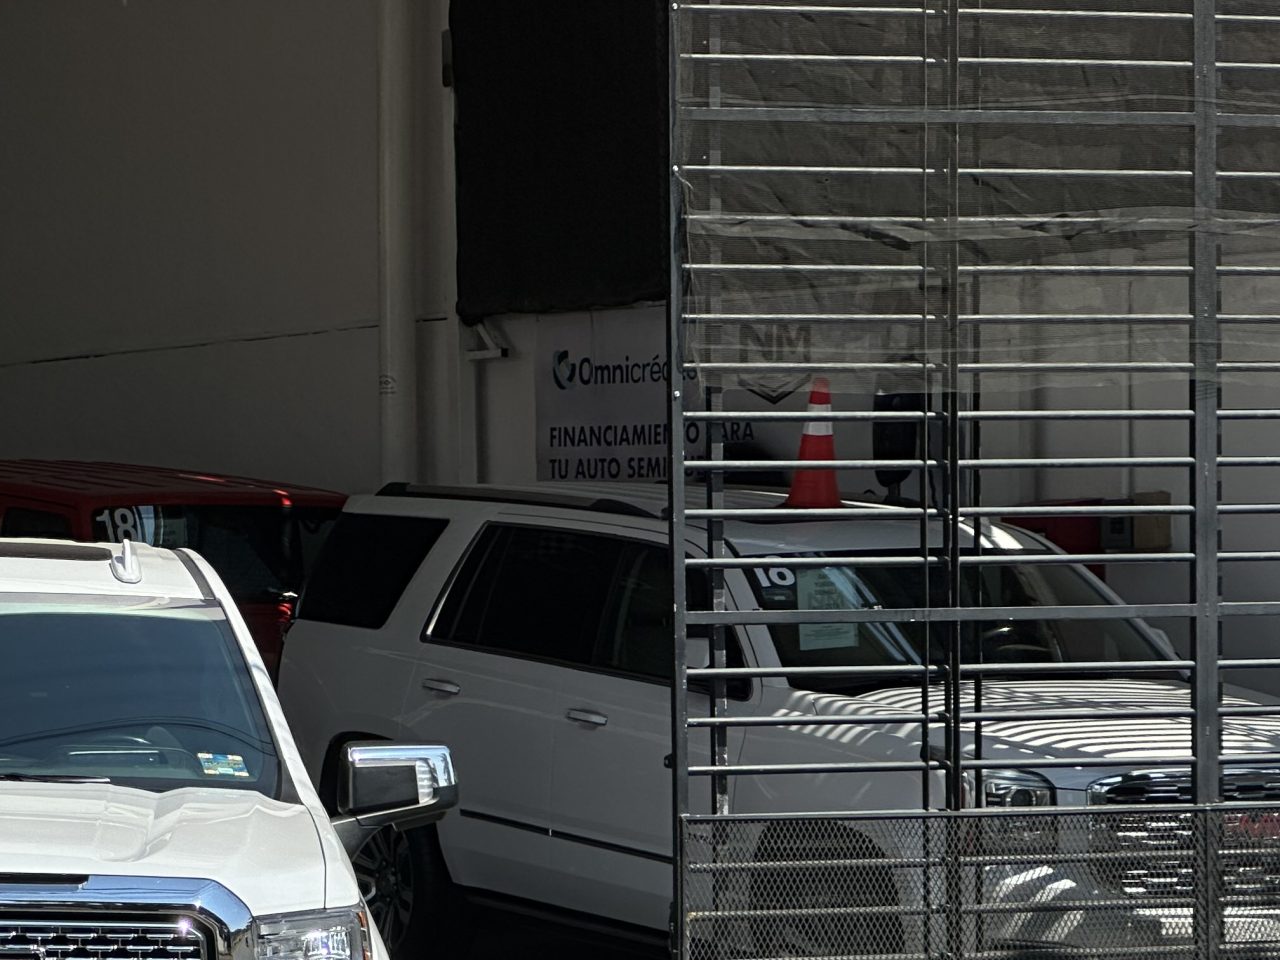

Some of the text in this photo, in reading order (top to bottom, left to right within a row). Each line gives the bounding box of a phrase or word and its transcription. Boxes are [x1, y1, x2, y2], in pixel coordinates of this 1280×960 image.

[739, 324, 811, 362] NM
[579, 354, 697, 385] Omnicréo
[549, 422, 754, 447] FINANCIAMIEO ARA
[549, 460, 569, 479] TU
[575, 459, 621, 479] AUTO
[95, 508, 137, 543] 18
